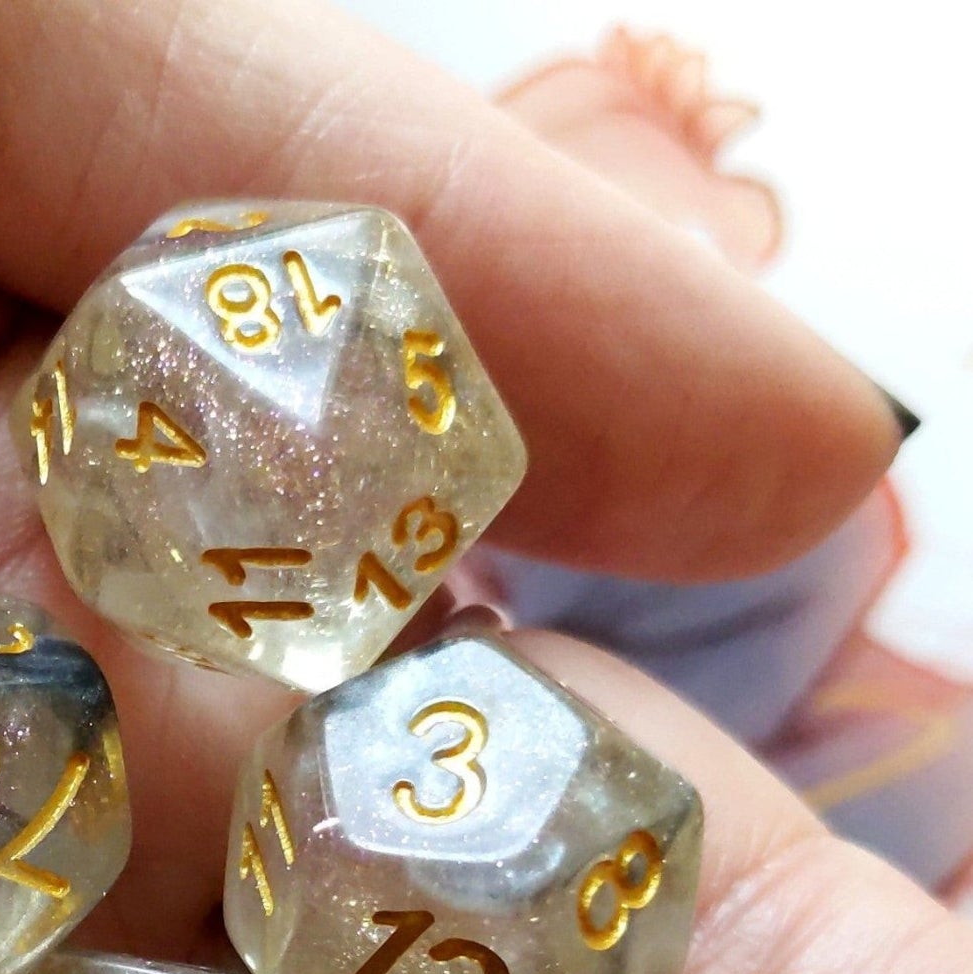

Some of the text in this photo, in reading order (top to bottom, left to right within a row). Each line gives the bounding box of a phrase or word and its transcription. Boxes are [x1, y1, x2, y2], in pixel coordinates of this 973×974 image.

[204, 249, 343, 354] 18
[403, 329, 456, 435] 5
[115, 401, 207, 473] 4
[200, 547, 316, 639] 11
[353, 496, 460, 610] 13
[392, 698, 489, 825] 3
[577, 828, 662, 951] 8
